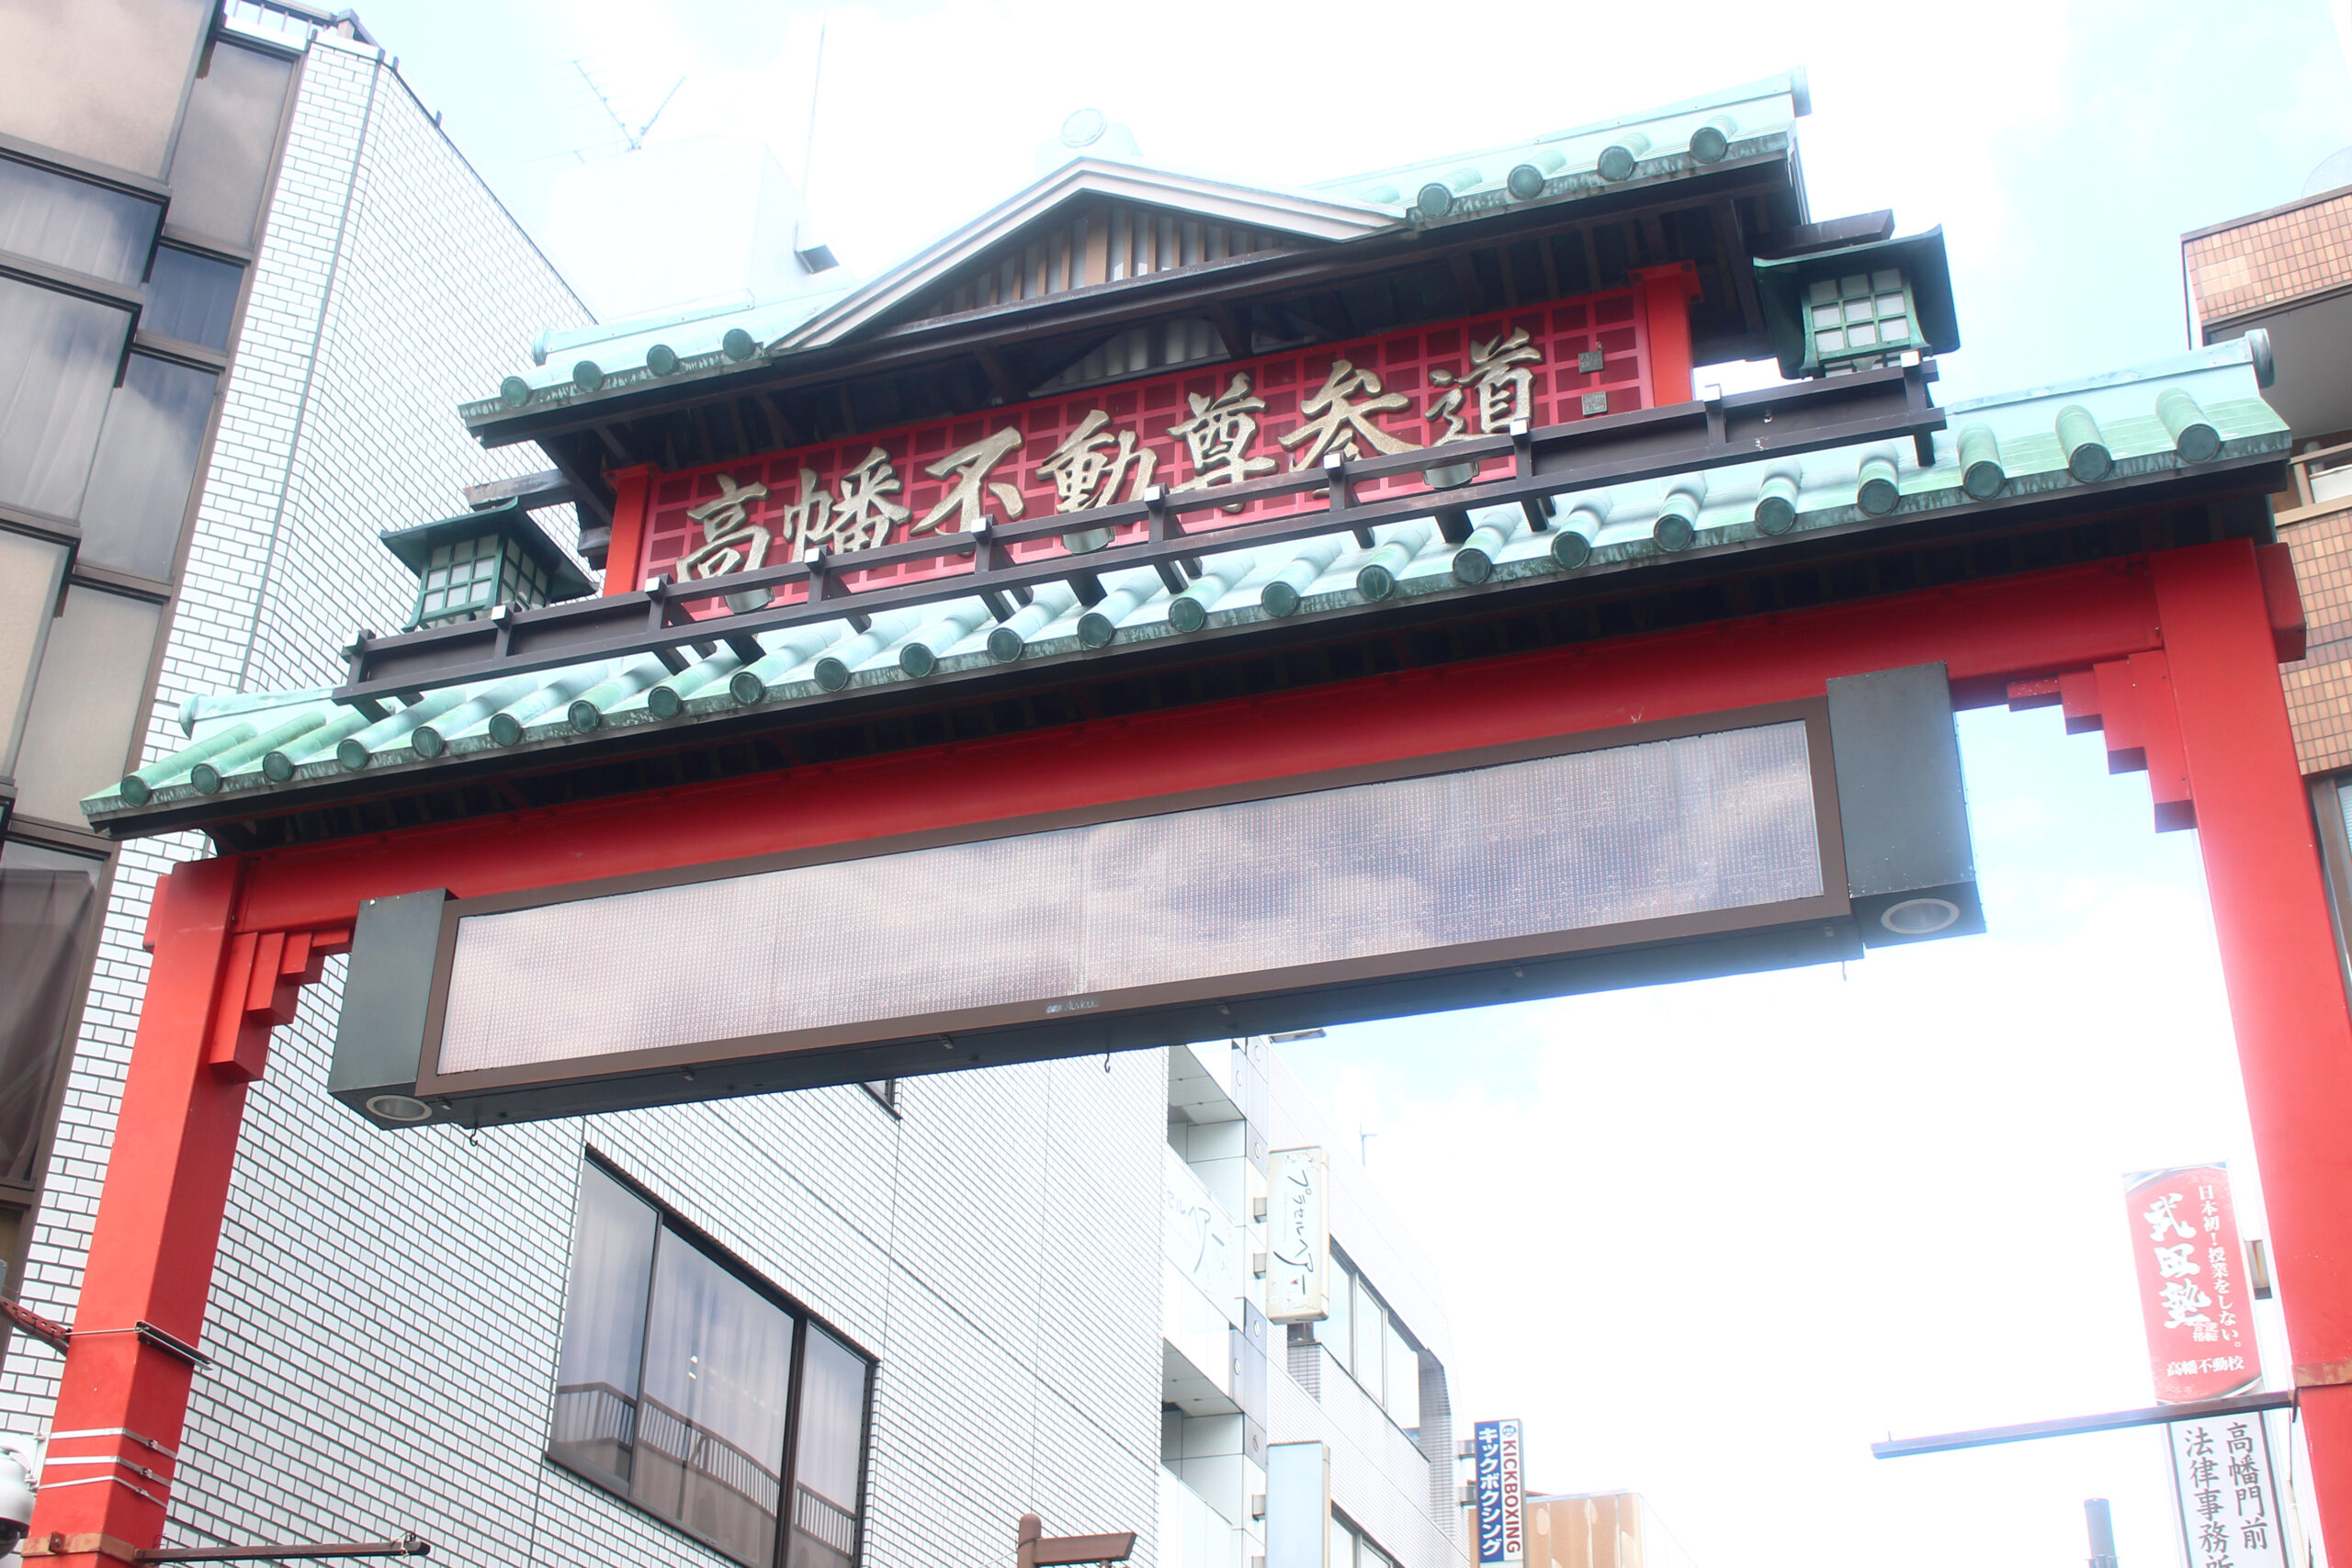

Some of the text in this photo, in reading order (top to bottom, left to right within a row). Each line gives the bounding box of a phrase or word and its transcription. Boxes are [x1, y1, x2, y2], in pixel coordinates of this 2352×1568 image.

[2143, 1192, 2212, 1329] 武田塾
[2166, 1355, 2245, 1377] 高幡不動校
[1478, 1427, 1502, 1556] キックボクシング
[1503, 1440, 1521, 1553] KICKBOXING
[2226, 1422, 2267, 1551] 高幡門前
